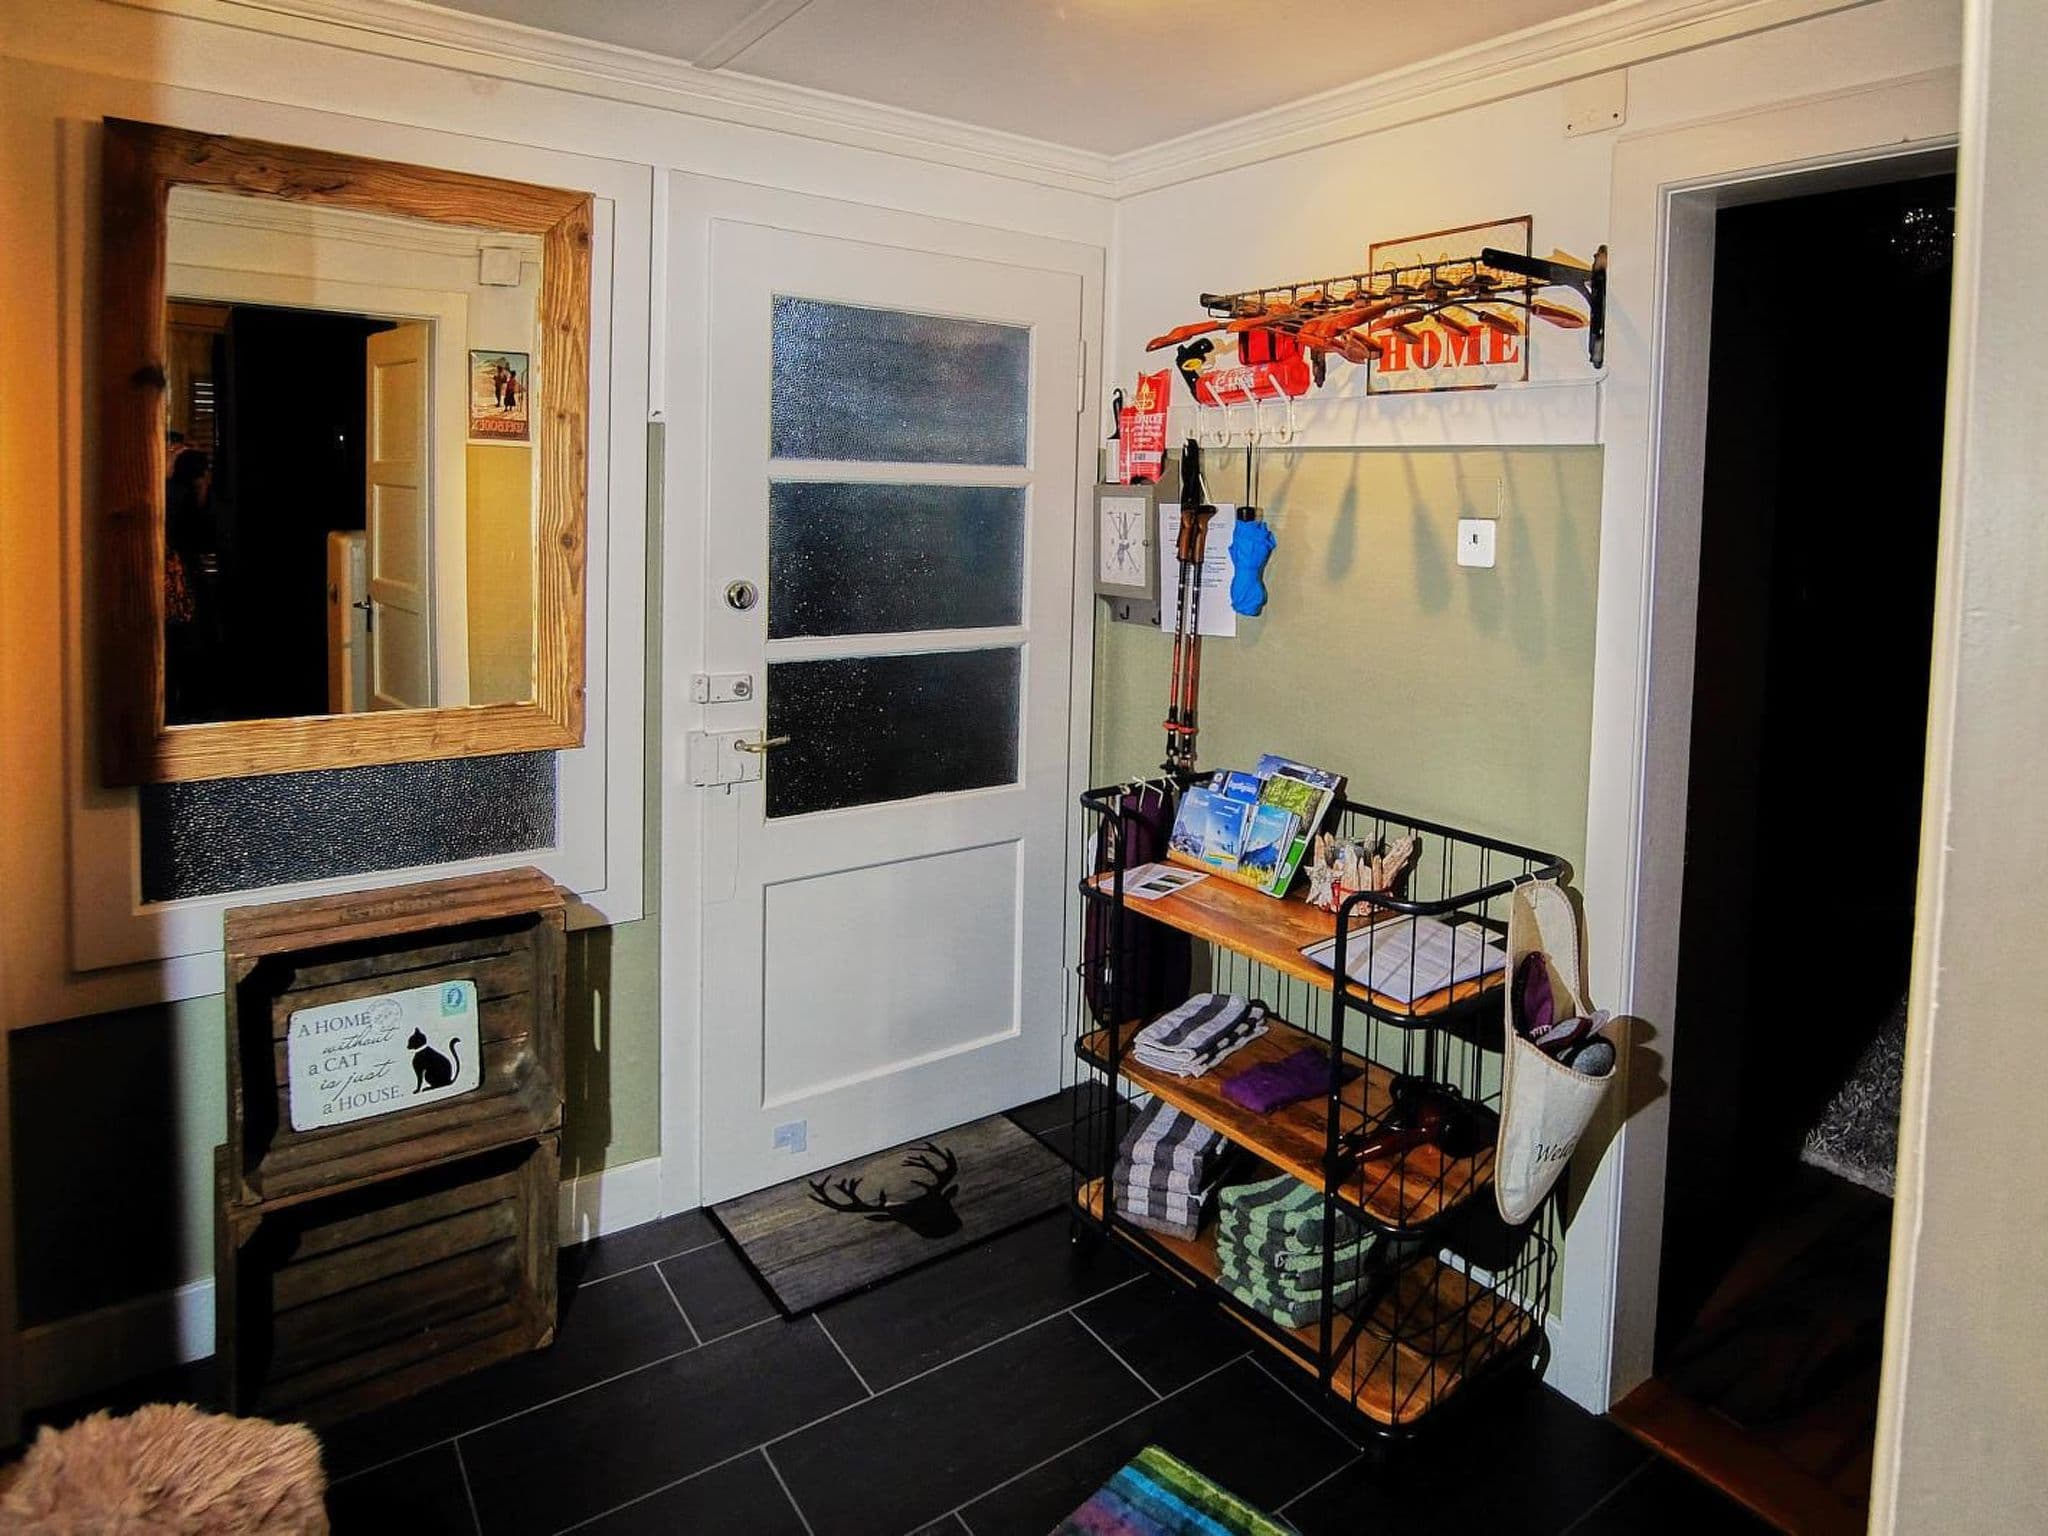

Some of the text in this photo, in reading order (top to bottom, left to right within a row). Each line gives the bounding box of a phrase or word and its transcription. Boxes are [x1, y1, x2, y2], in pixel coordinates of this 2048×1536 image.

[1377, 323, 1519, 372] HOME
[298, 1024, 310, 1038] A
[315, 1012, 372, 1034] HOME
[322, 1024, 399, 1054] without
[308, 1053, 362, 1076] a CAT
[320, 1059, 399, 1102] is just
[322, 1085, 404, 1115] a HOUSE.
